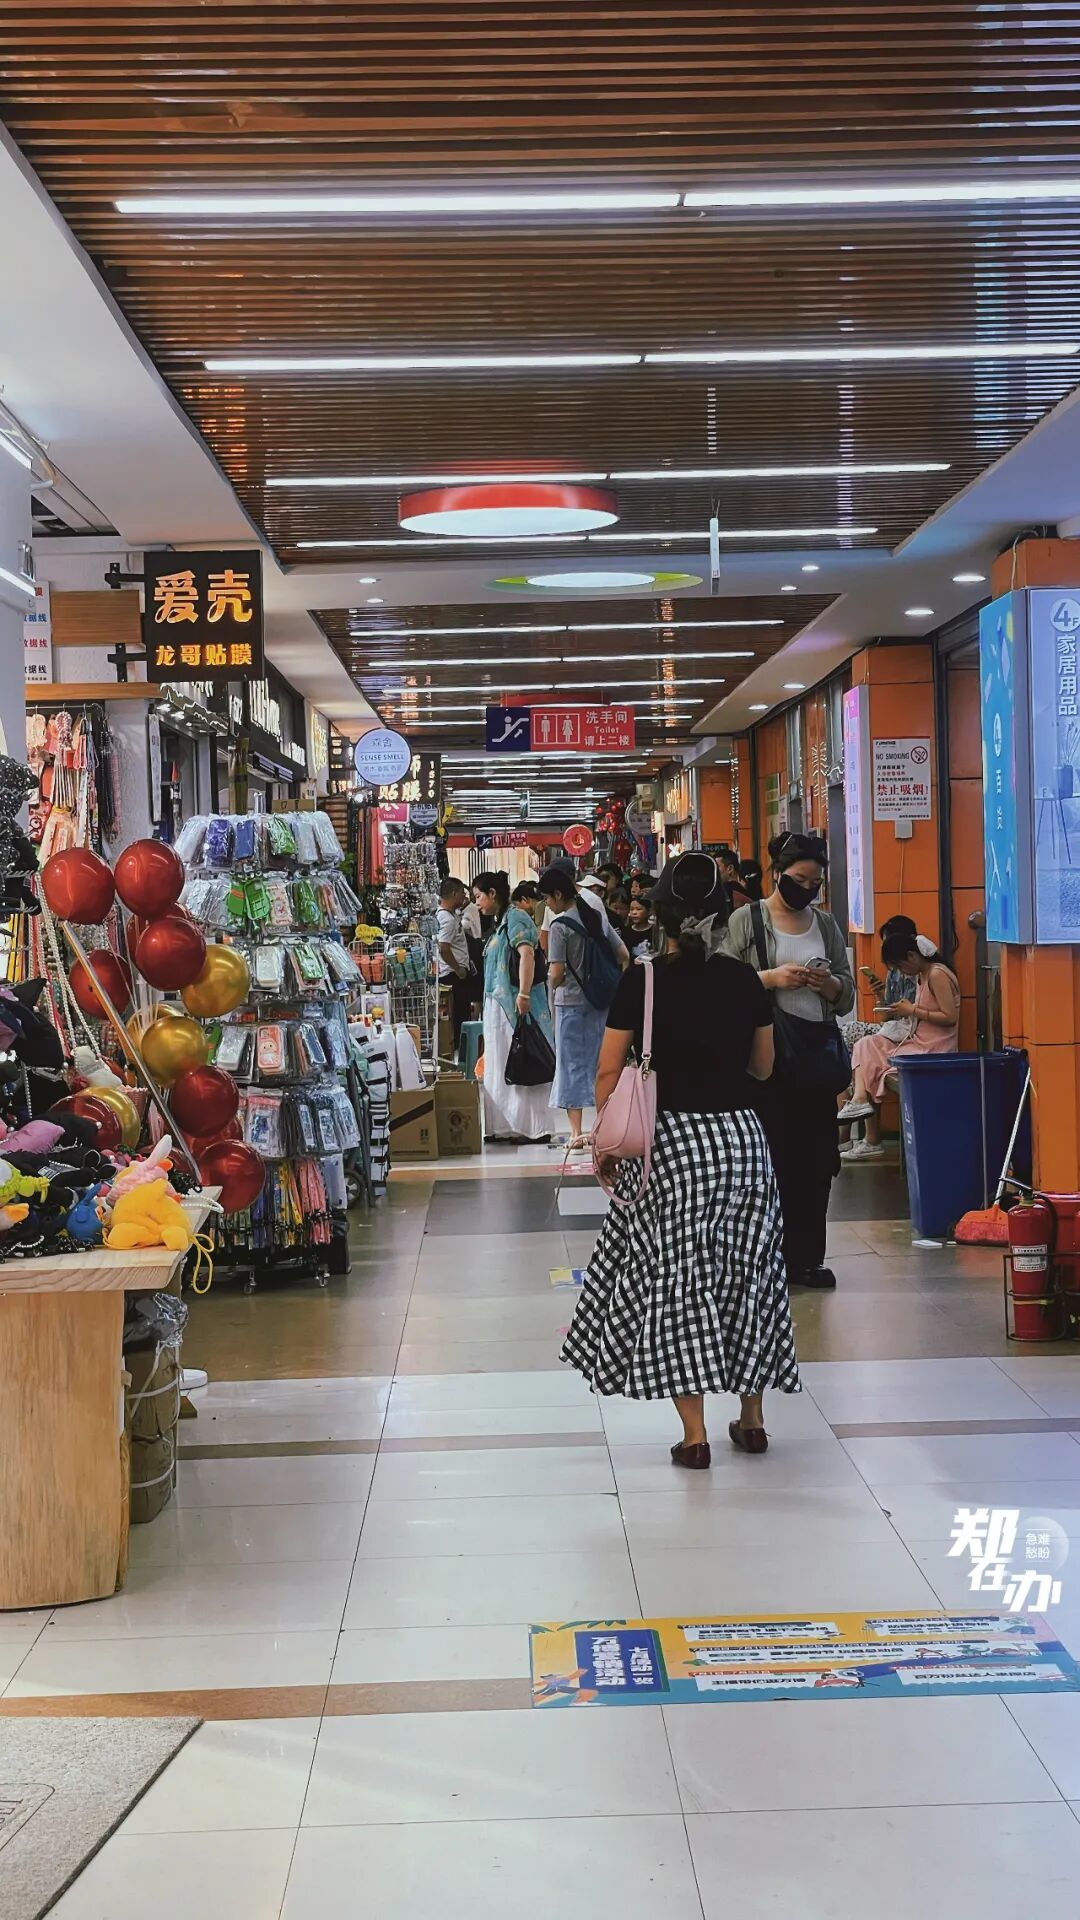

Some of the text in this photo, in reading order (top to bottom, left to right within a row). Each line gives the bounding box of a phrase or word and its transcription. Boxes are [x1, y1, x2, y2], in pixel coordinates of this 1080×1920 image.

[154, 569, 253, 624] 爱壳
[155, 643, 253, 666] 龙哥贴膜
[1057, 635, 1079, 717] 家居用品
[586, 711, 628, 724] 洗手间
[594, 726, 619, 734] Toilet
[584, 735, 630, 747] 请上二楼
[360, 753, 405, 762] SENSE SMELL
[875, 752, 910, 761] NO SMOKING
[377, 782, 422, 801] 贴膜
[876, 784, 924, 797] 禁止吸烟
